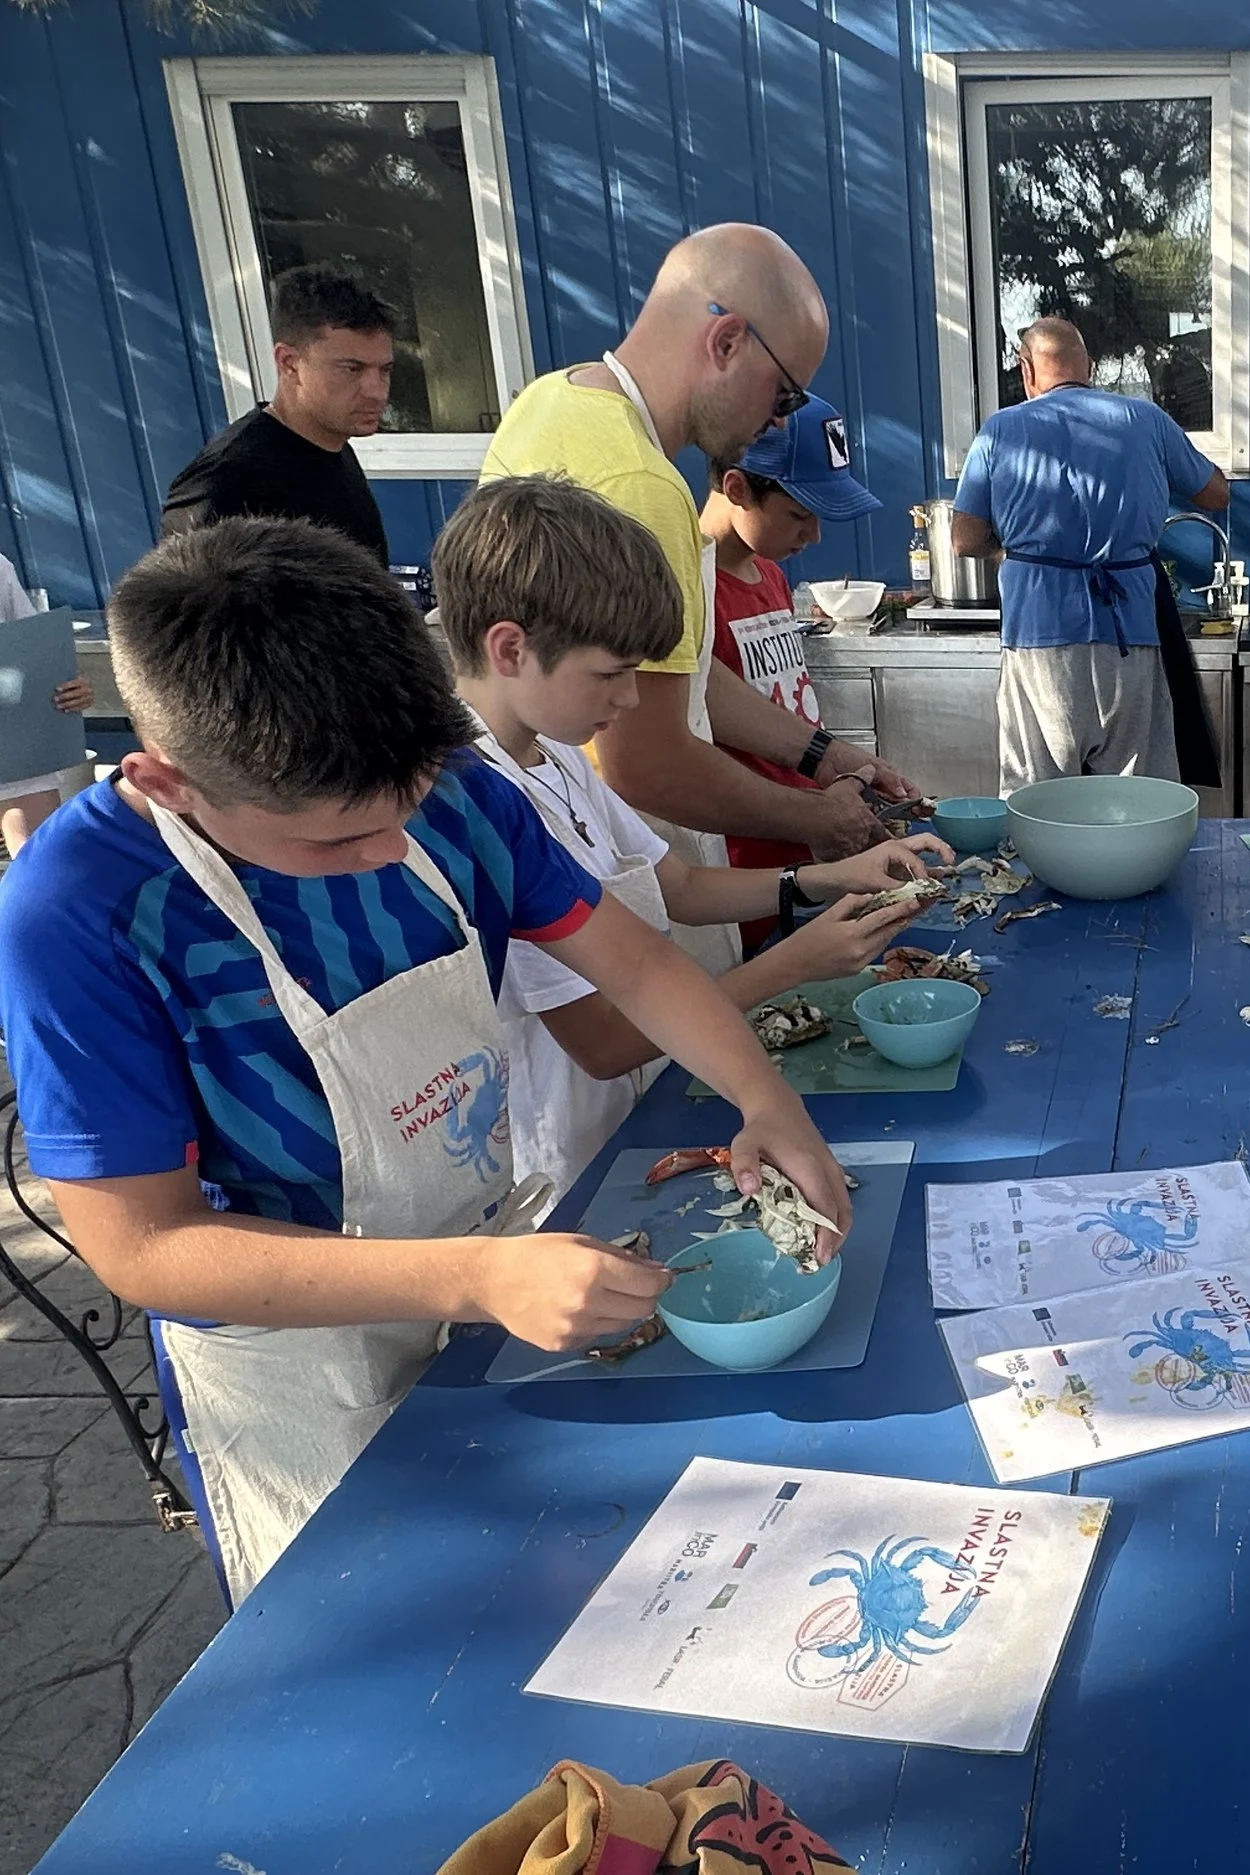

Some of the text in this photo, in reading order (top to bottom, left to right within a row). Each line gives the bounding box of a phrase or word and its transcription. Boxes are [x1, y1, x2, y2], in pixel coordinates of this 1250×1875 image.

[744, 631, 803, 680] INSTITU
[390, 1062, 460, 1122] SLASTNA
[400, 1082, 471, 1143] INVAZIJA
[1156, 1178, 1179, 1222] INVAZIJA
[1176, 1177, 1201, 1219] SLASTNA
[1195, 1279, 1239, 1334] INVAZIJA
[693, 1532, 718, 1558] MAR
[940, 1507, 995, 1594] INVAZIJA
[971, 1510, 1022, 1598] SLASTNA
